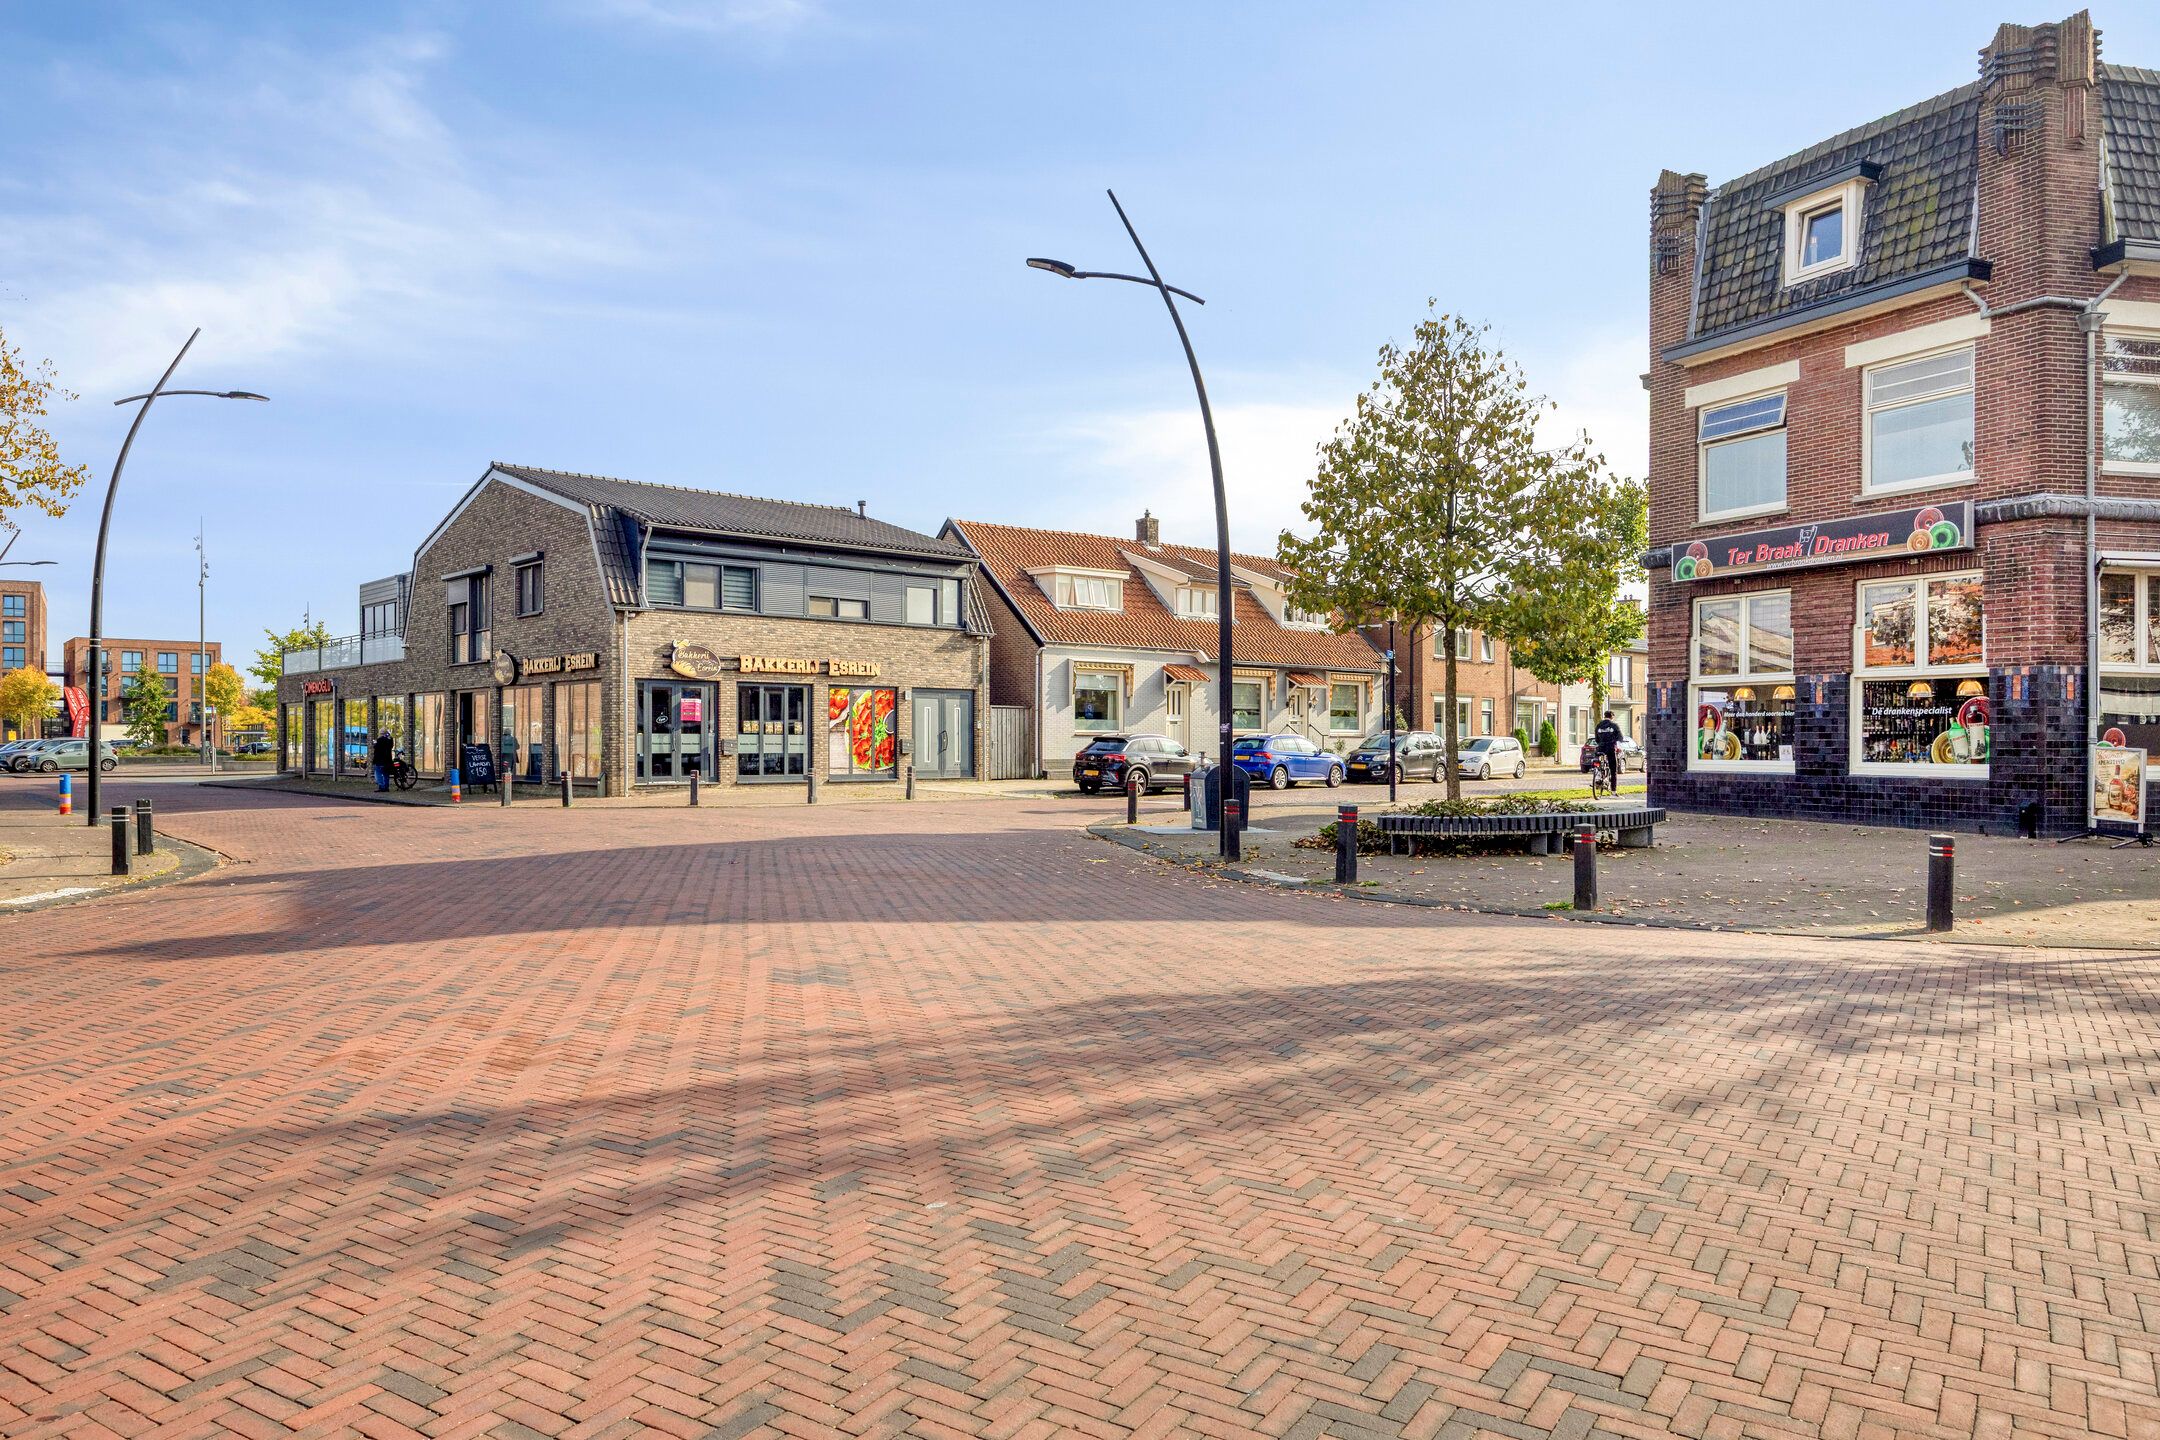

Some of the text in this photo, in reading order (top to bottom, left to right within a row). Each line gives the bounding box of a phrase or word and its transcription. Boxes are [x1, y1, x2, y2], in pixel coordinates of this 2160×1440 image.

[1727, 531, 1890, 566] Ter Braak Dranken
[522, 656, 561, 676] BAKKERIJ
[565, 652, 595, 673] ESREIN
[739, 654, 881, 676] BAKKERIJ ESREIN
[1883, 705, 1953, 717] drankenspecialist
